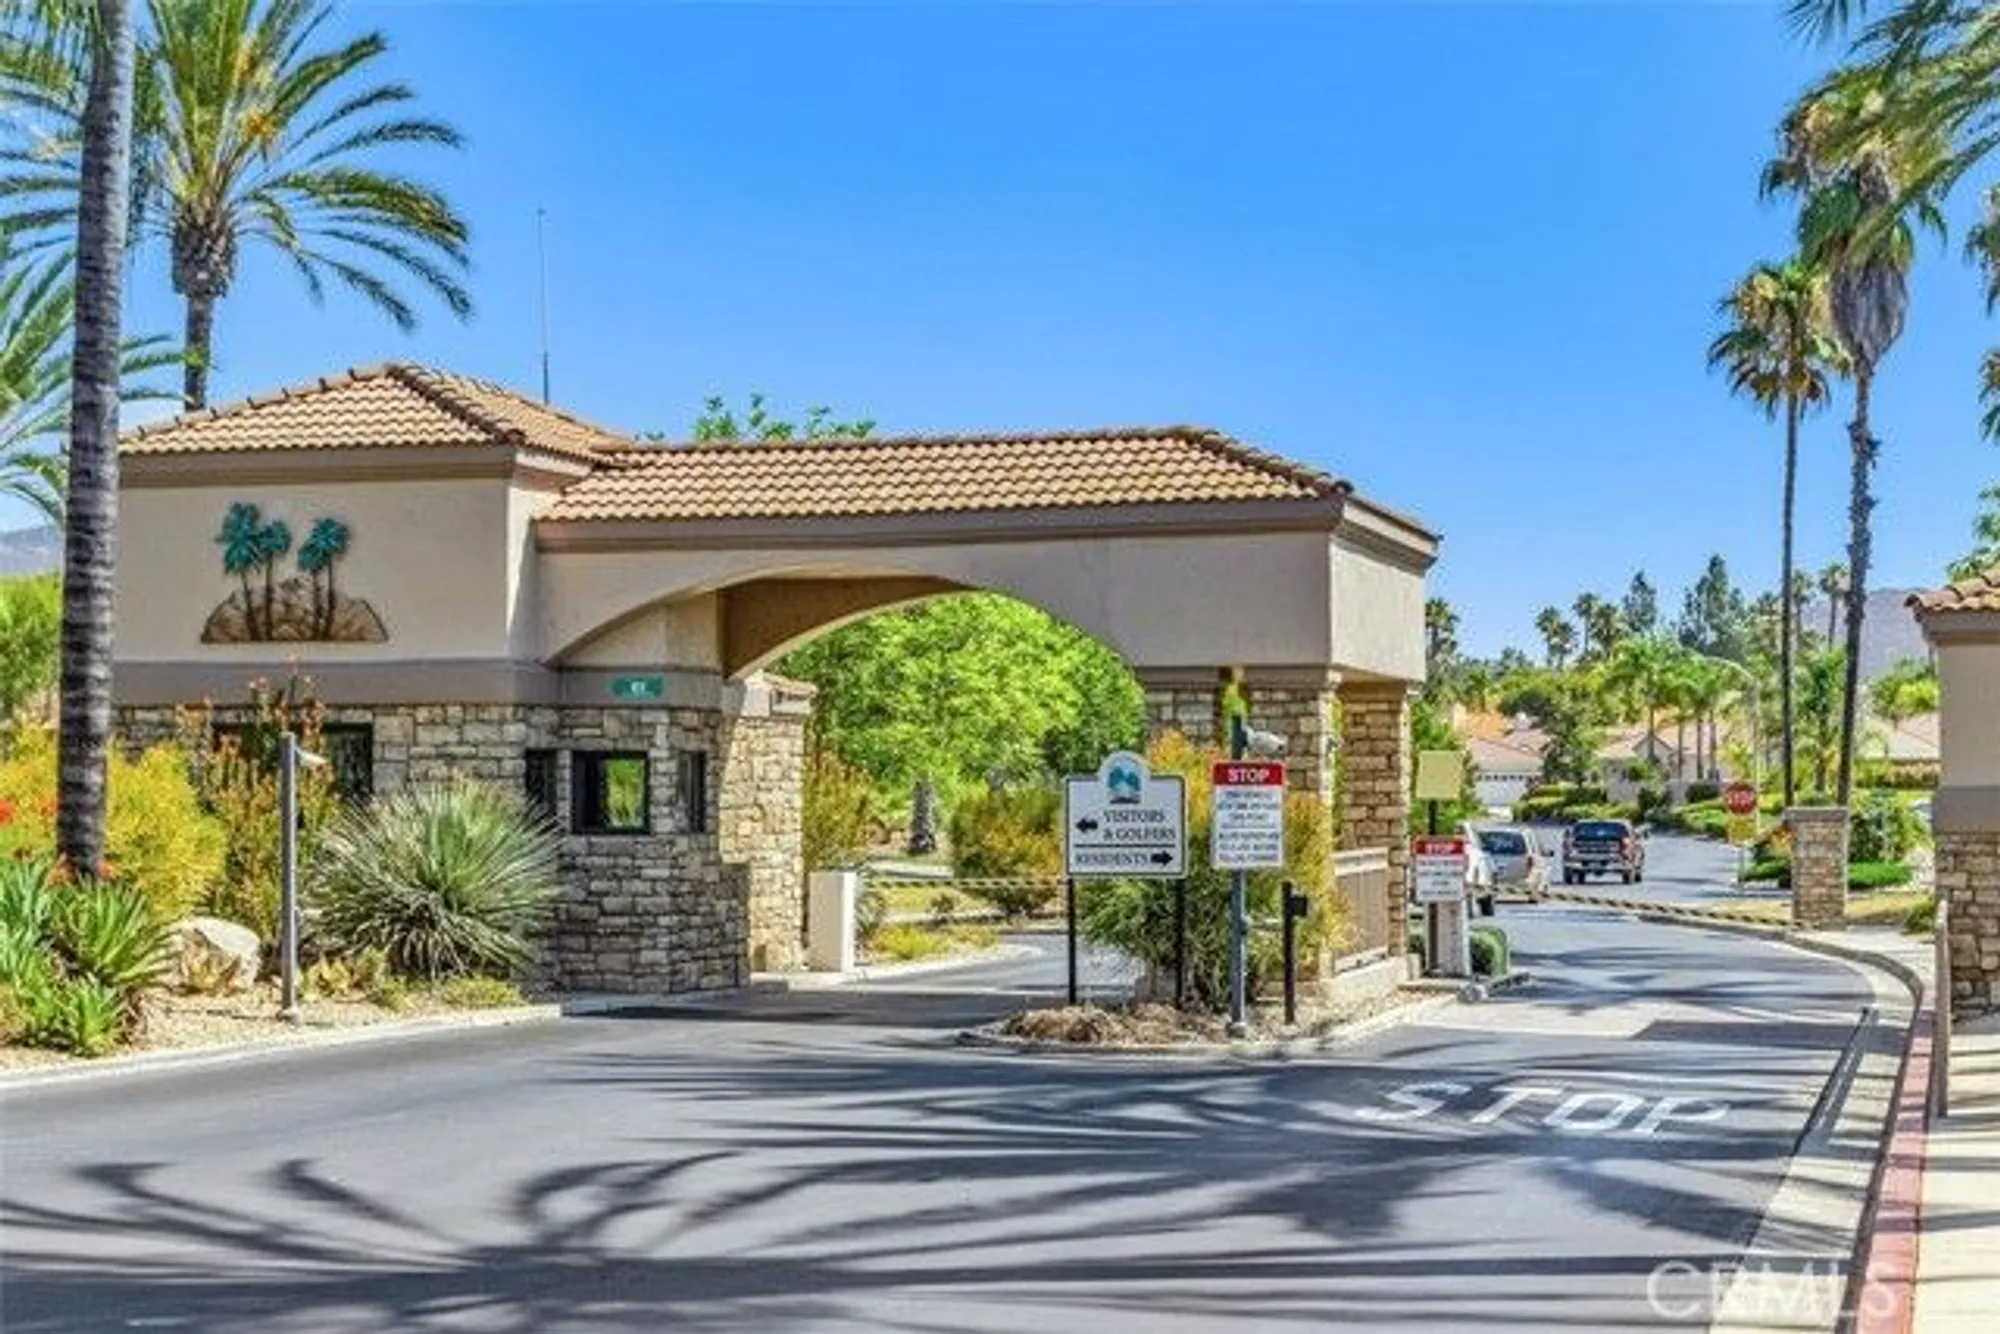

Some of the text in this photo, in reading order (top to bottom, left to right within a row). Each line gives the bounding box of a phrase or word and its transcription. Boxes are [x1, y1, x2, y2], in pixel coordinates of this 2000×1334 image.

[1228, 768, 1270, 782] STOP
[1103, 810, 1165, 823] VISITORS
[1116, 827, 1176, 840] GOLFERS
[1425, 843, 1456, 855] STOP
[1075, 853, 1148, 866] RESIDENTS
[1354, 1082, 1730, 1134] STOP
